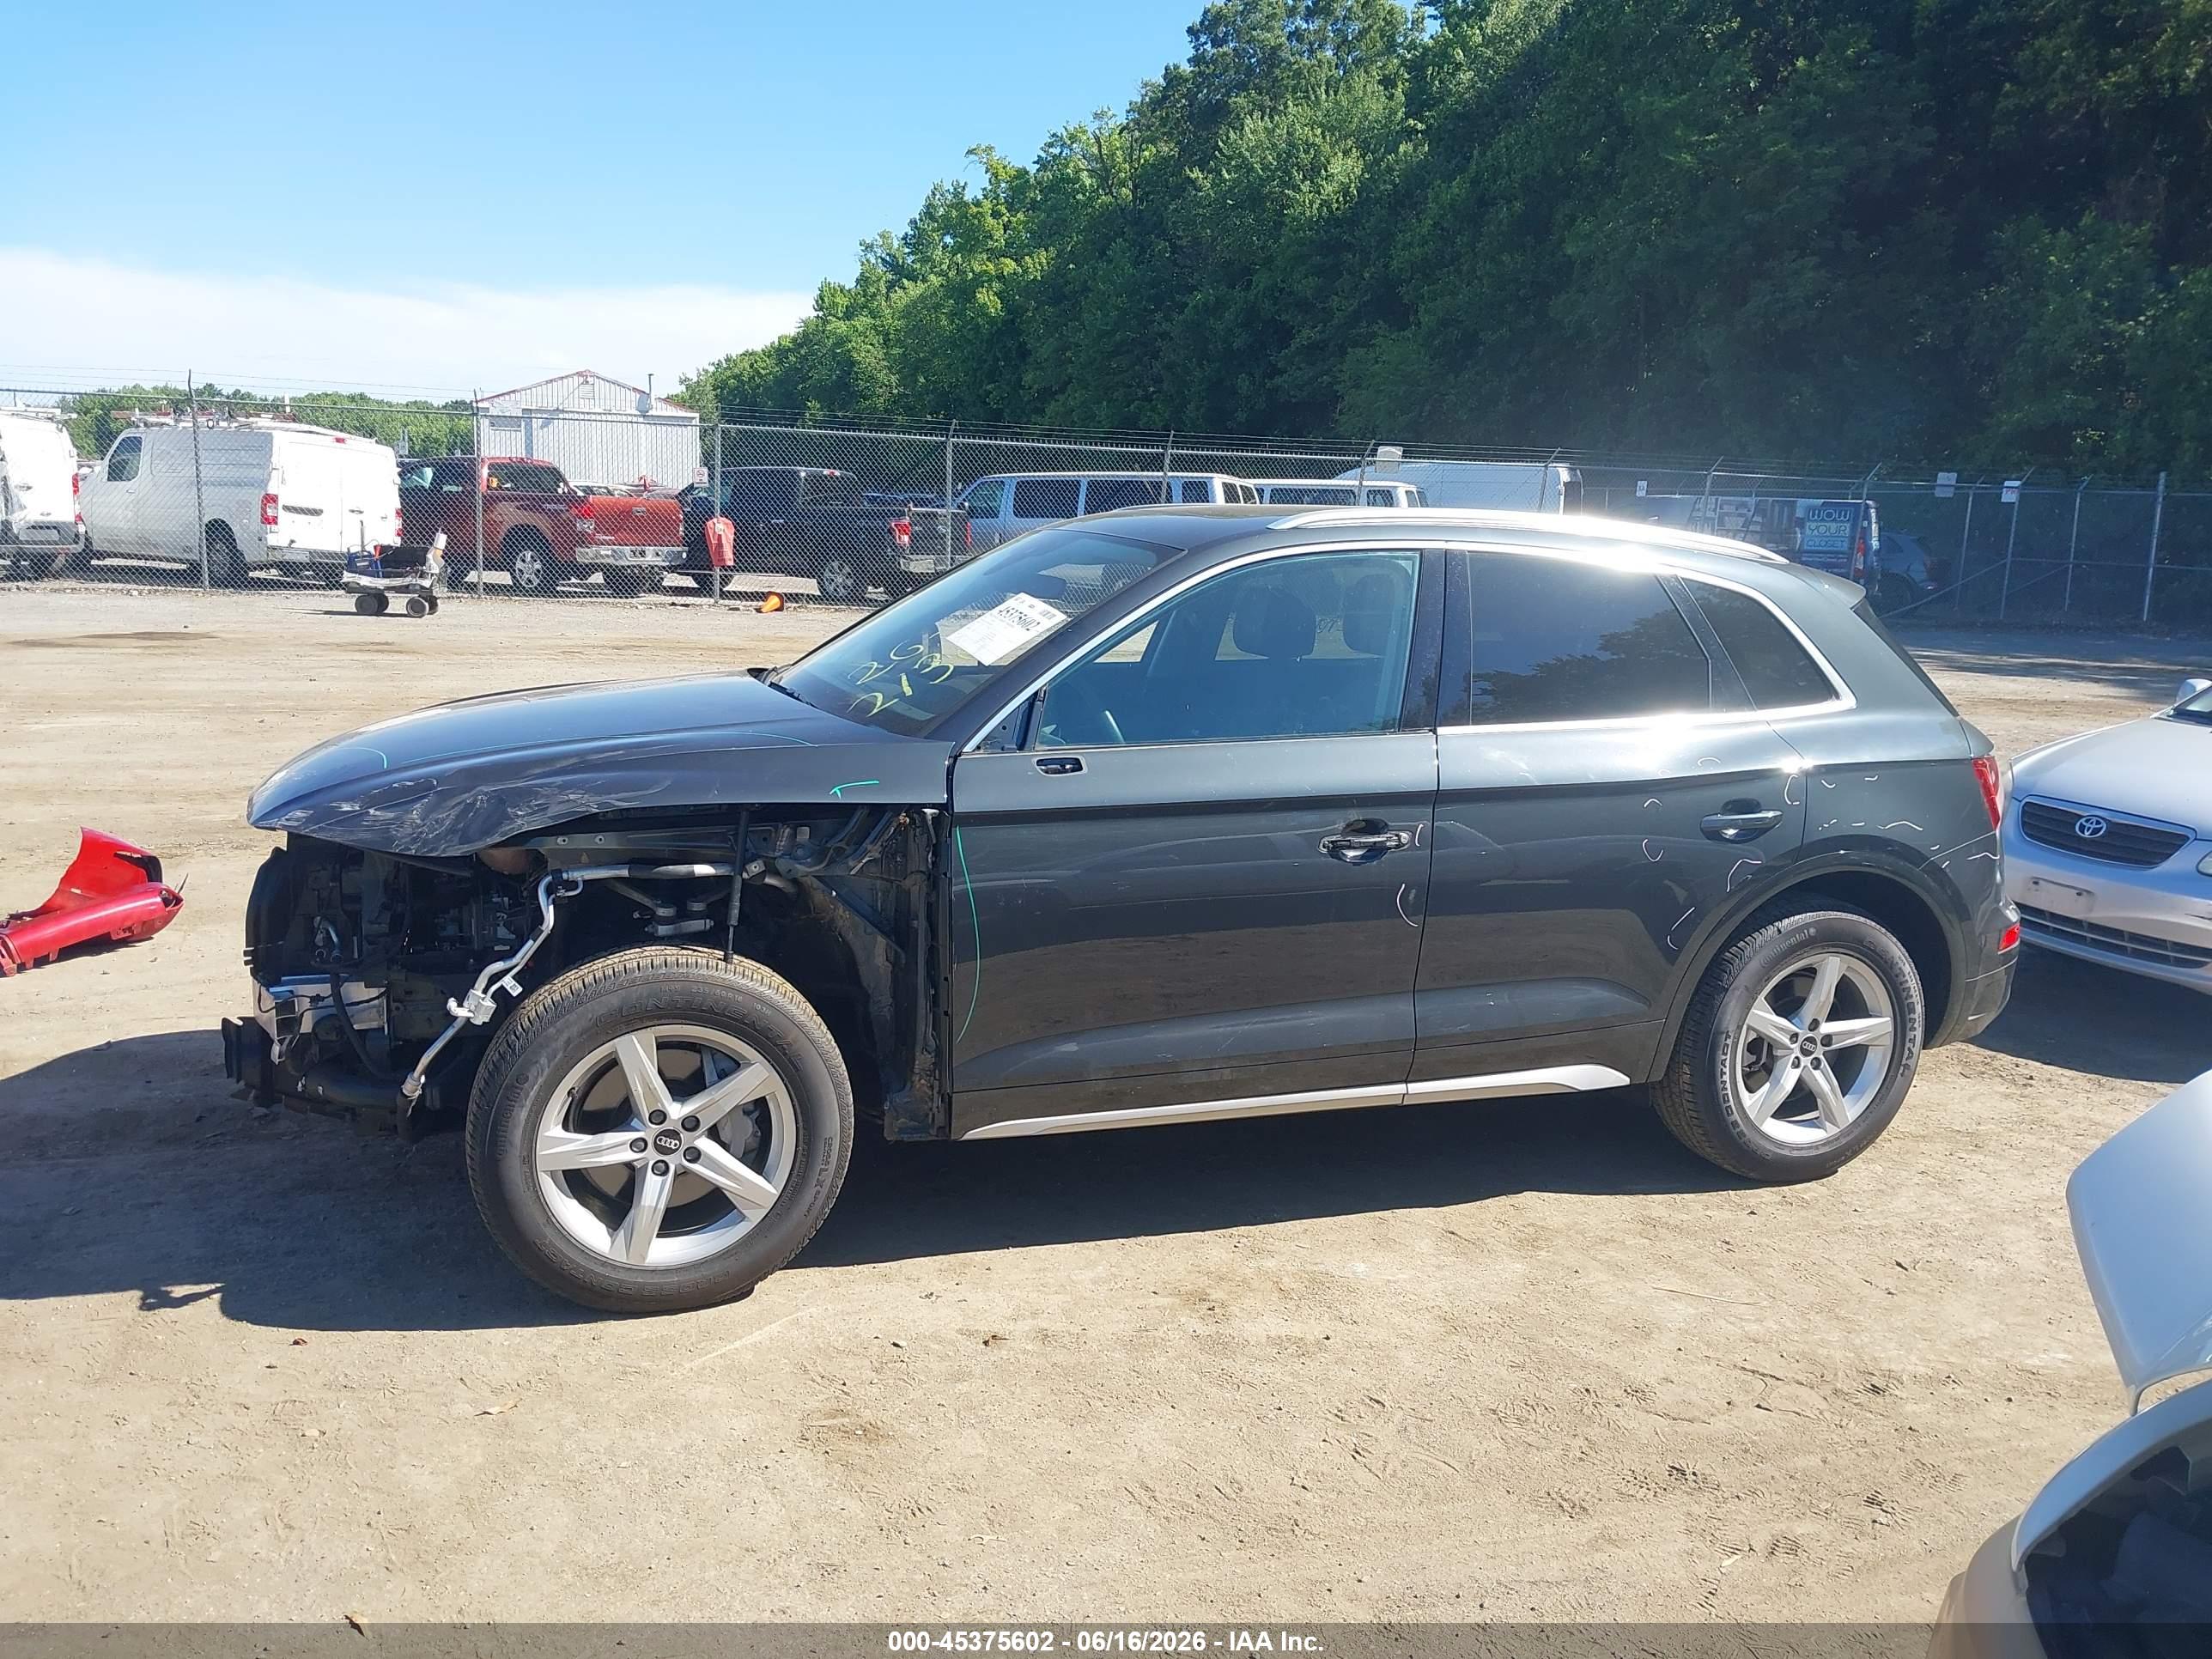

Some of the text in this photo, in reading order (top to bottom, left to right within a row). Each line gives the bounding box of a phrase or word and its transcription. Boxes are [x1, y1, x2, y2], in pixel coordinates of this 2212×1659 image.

[1809, 509, 1849, 520] WOW
[1808, 525, 1847, 536] YOUR
[1806, 539, 1845, 548] CLOSET
[997, 605, 1041, 631] 45375602
[1863, 939, 1917, 1077] CONTINENTAL
[594, 995, 805, 1073] CONTINENTAL
